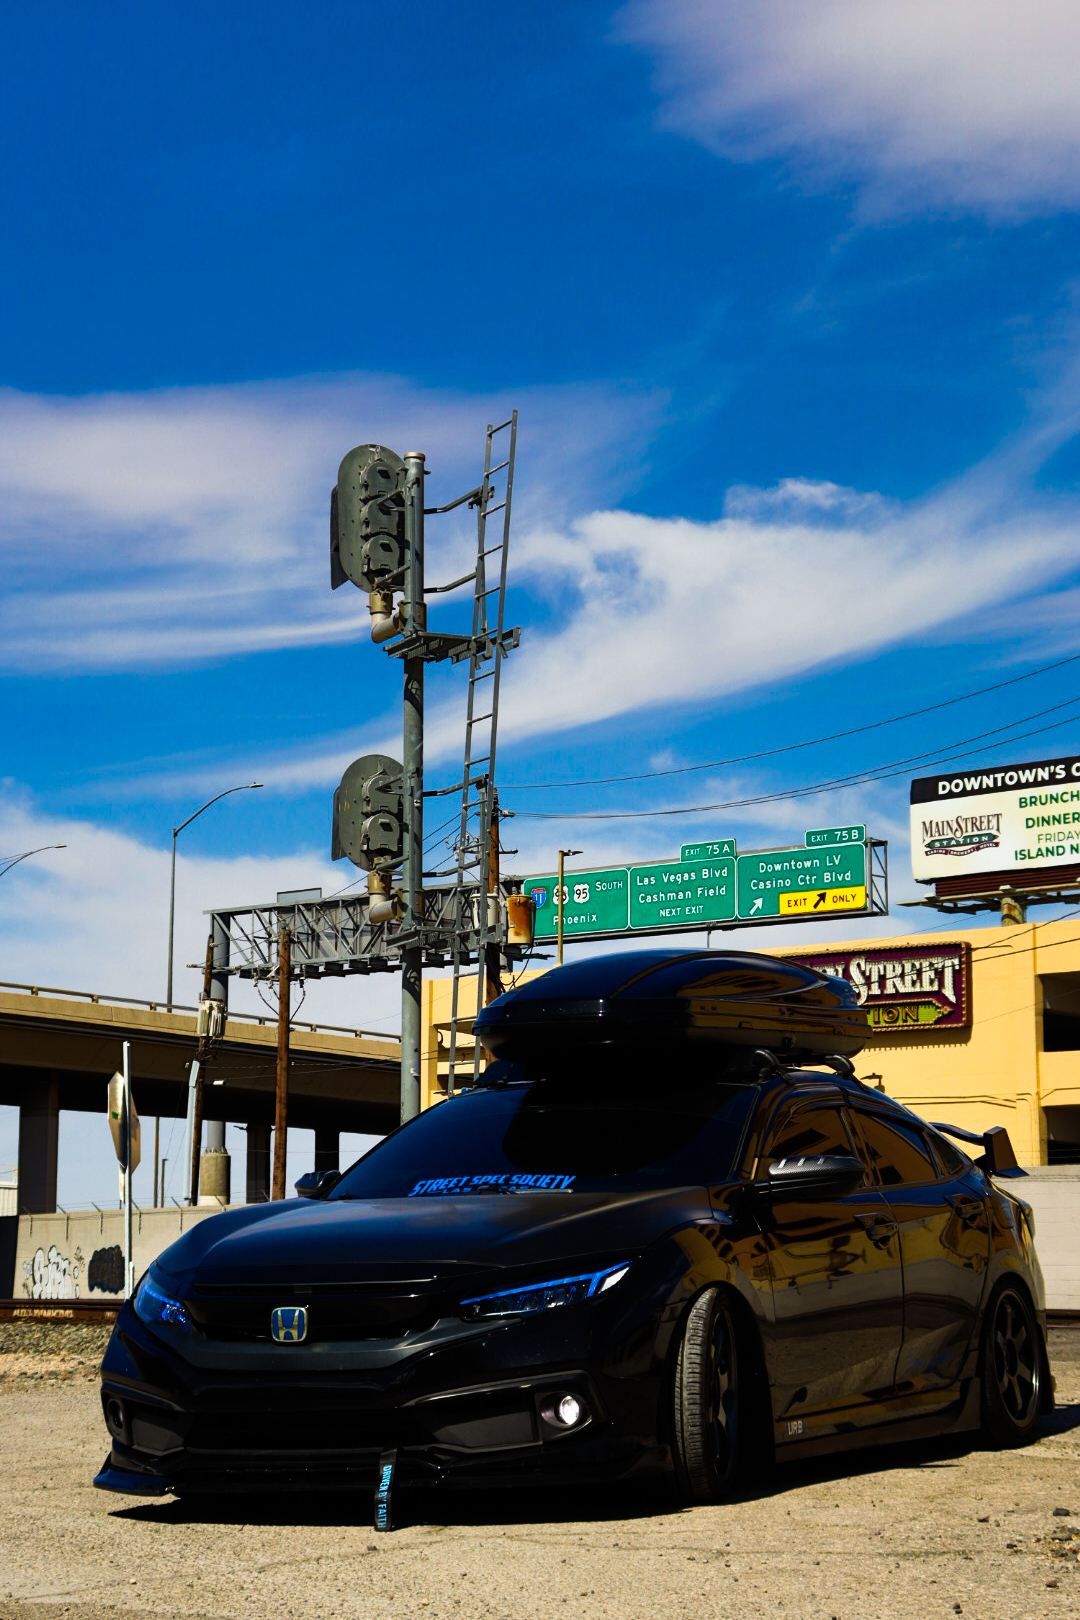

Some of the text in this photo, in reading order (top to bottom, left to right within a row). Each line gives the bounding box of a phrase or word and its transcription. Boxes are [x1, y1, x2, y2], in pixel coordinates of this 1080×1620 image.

[938, 764, 1066, 795] DOWNTOWN'S
[1019, 790, 1080, 808] BRUNCH
[1025, 811, 1080, 829] DINNER
[811, 834, 828, 843] EXIT
[934, 836, 989, 848] STATION
[1037, 829, 1080, 844] FRIDAY
[685, 848, 700, 856] EXIT
[1014, 845, 1066, 861] ISLAND
[759, 854, 841, 873] Downtown LV
[636, 866, 728, 886] Las Vegas Blvd
[750, 870, 851, 890] Casino Ctr Blvd
[575, 888, 588, 899] 95
[595, 881, 623, 891] SOUTH
[638, 885, 726, 904] Cashman Field
[787, 893, 857, 908] EXIT ONLY
[659, 905, 704, 917] NEXT EXIT
[408, 1174, 577, 1198] STREET SPEC SOCIETY
[379, 1464, 392, 1491] DRIVEN
[377, 1503, 387, 1529] FAITH
